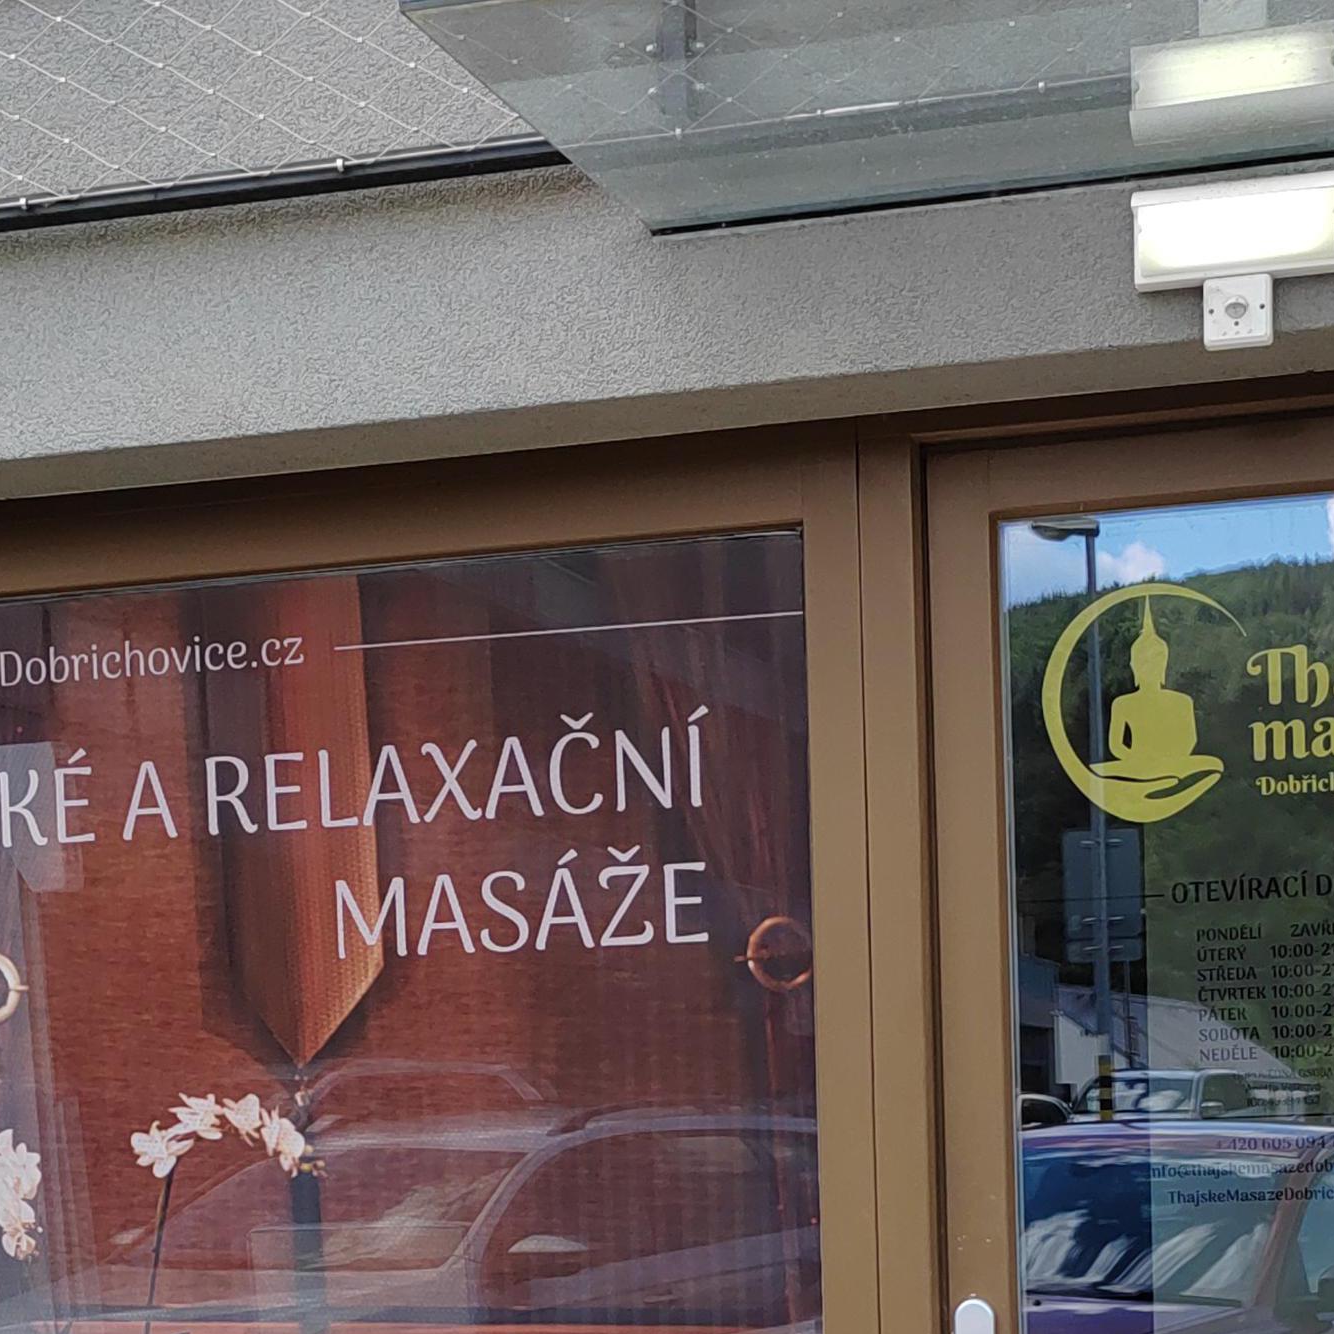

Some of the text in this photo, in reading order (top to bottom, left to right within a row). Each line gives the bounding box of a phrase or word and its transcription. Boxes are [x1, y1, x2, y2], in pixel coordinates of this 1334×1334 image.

[122, 760, 179, 841] A
[204, 704, 709, 837] RELAXAČNÍ
[1171, 870, 1308, 904] OTEVÍRACÍ
[334, 845, 709, 960] MASÁŽE
[1198, 985, 1267, 1003] ČTVRTEK
[1199, 1006, 1248, 1022] PÁTEK
[1199, 1026, 1260, 1042] SOBOTA
